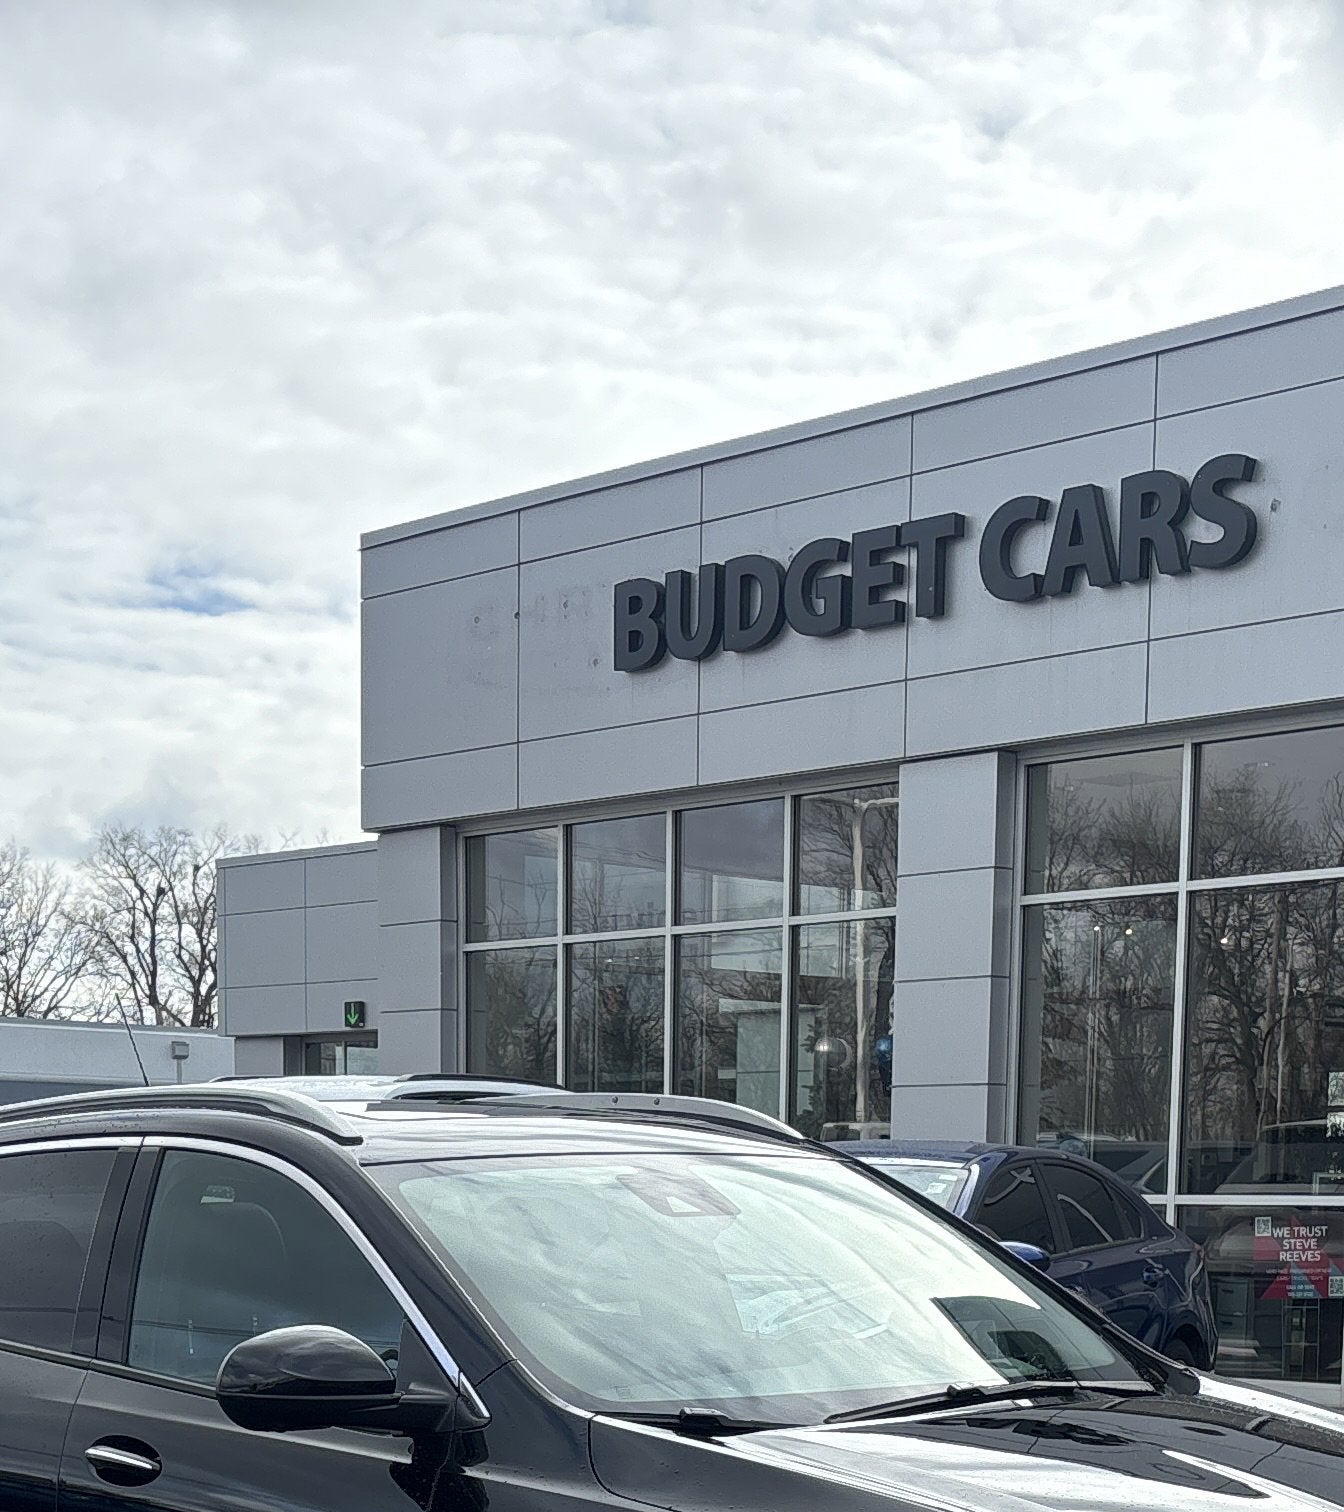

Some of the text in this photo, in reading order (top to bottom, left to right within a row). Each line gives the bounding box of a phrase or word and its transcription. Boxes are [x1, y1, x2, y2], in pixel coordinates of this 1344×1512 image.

[614, 453, 1257, 672] BUDGET CARS
[1272, 1226, 1328, 1238] WE TRUST
[1282, 1239, 1318, 1250] STEVE
[1279, 1251, 1321, 1261] REEVES
